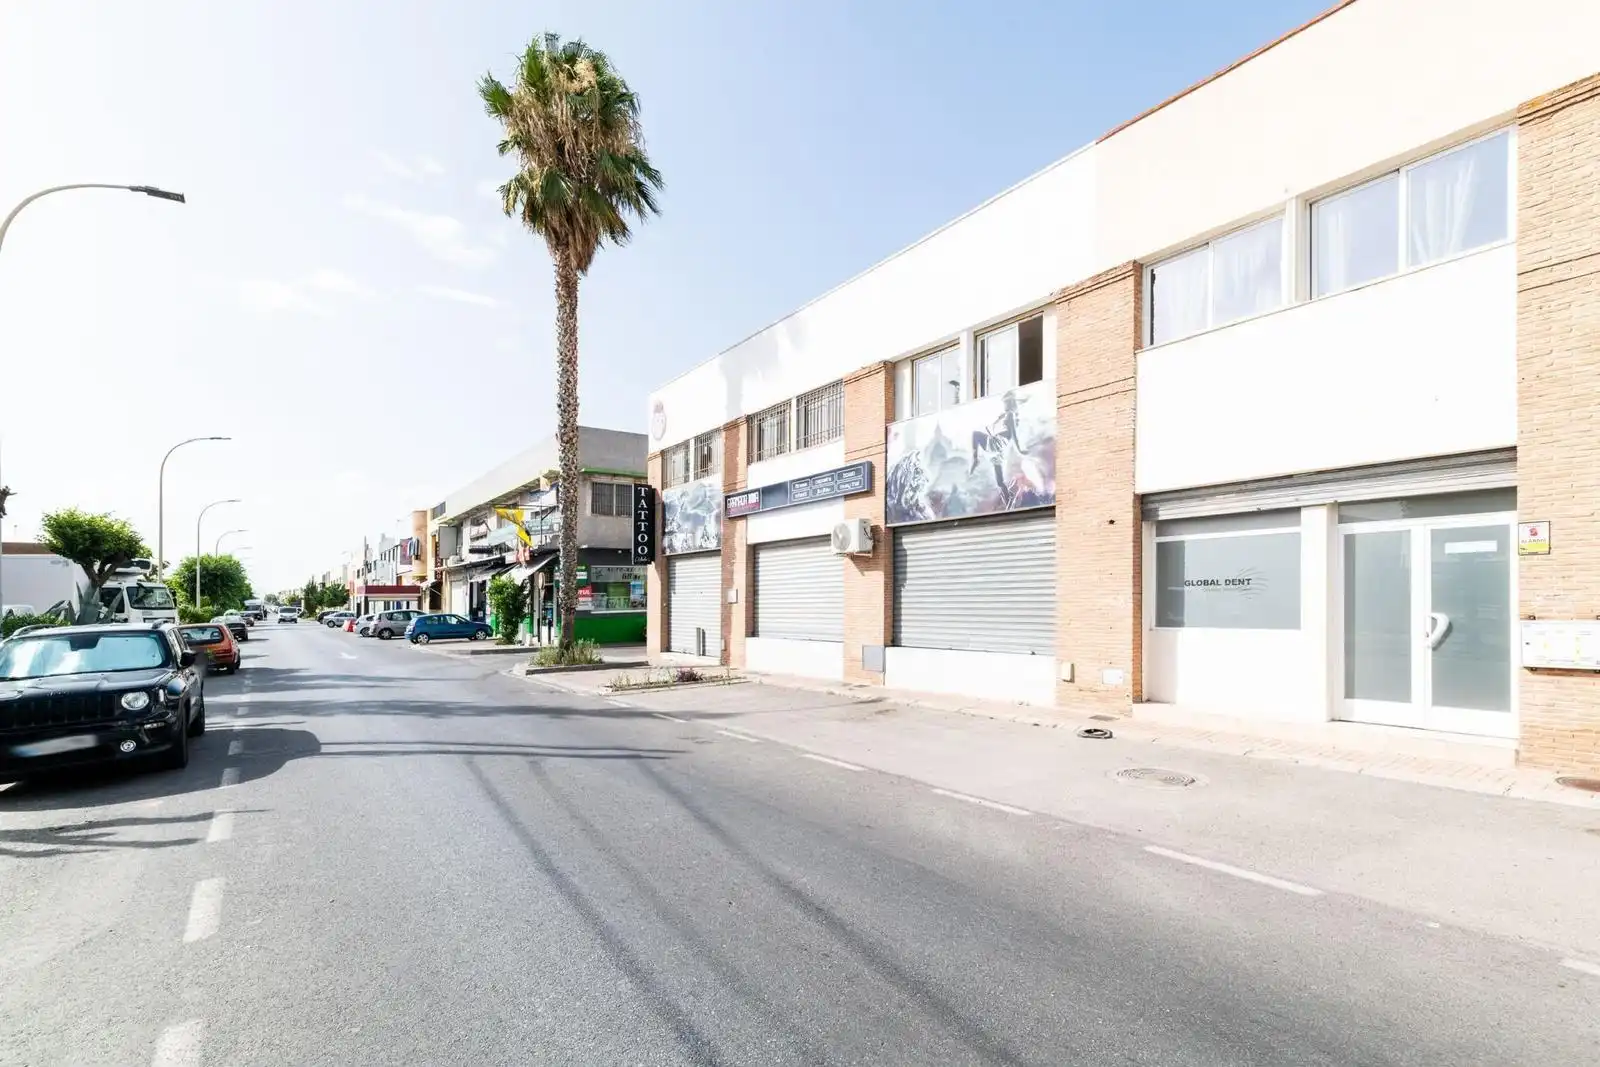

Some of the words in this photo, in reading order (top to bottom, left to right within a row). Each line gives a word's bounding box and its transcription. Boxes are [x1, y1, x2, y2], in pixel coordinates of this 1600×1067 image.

[637, 487, 649, 555] TATTOO
[1184, 579, 1222, 587] GLOBAL
[1224, 578, 1252, 586] DENT
